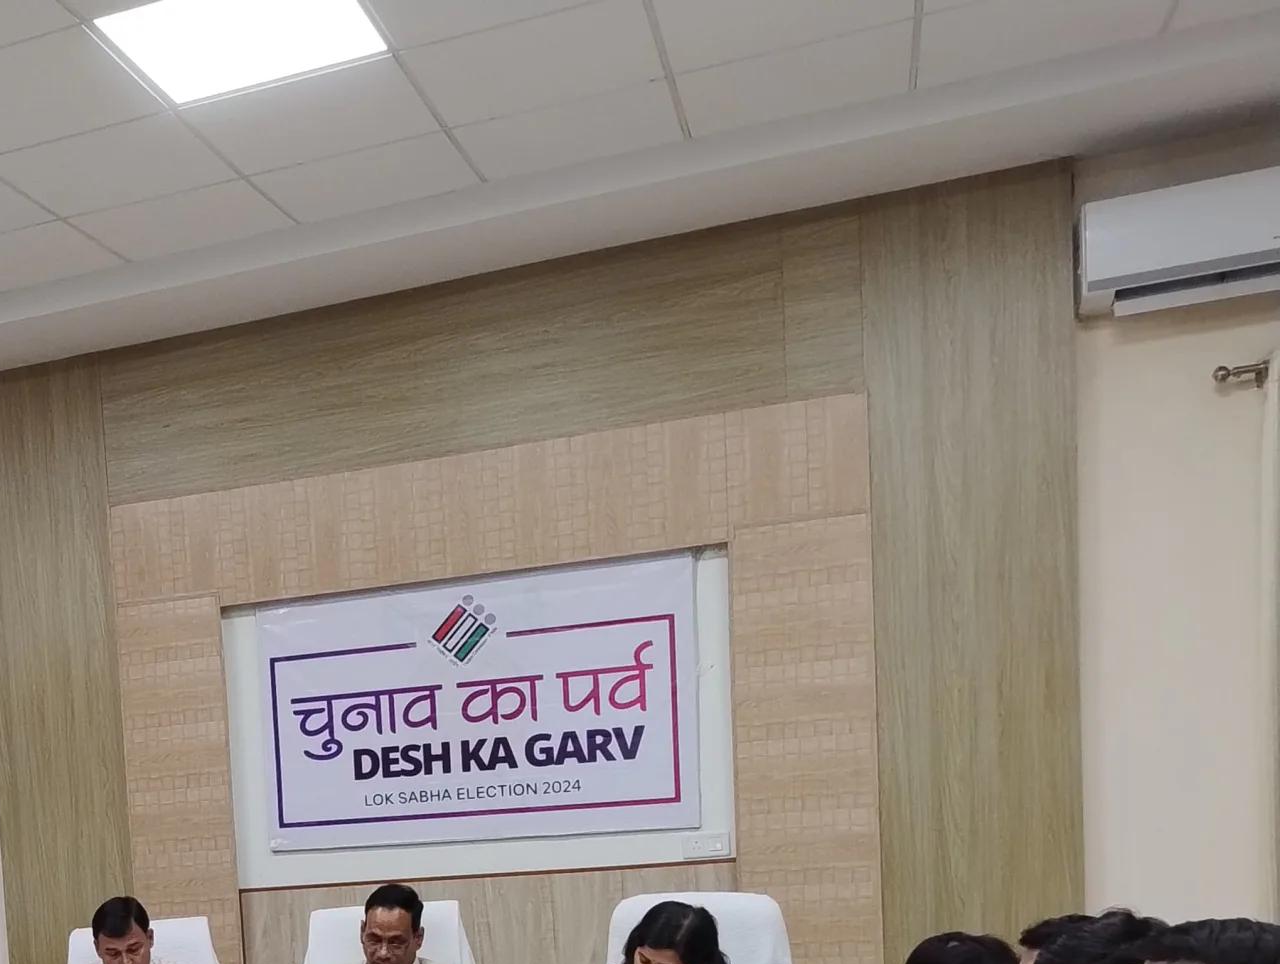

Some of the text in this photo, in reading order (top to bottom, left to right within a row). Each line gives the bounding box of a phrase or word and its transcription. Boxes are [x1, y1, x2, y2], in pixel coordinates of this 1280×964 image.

[291, 684, 442, 760] चुनाव
[456, 675, 543, 724] का
[556, 640, 653, 716] पर्व
[353, 725, 645, 780] DESH KA GARV
[364, 779, 582, 807] LOK SABHA ELECTION 2024
